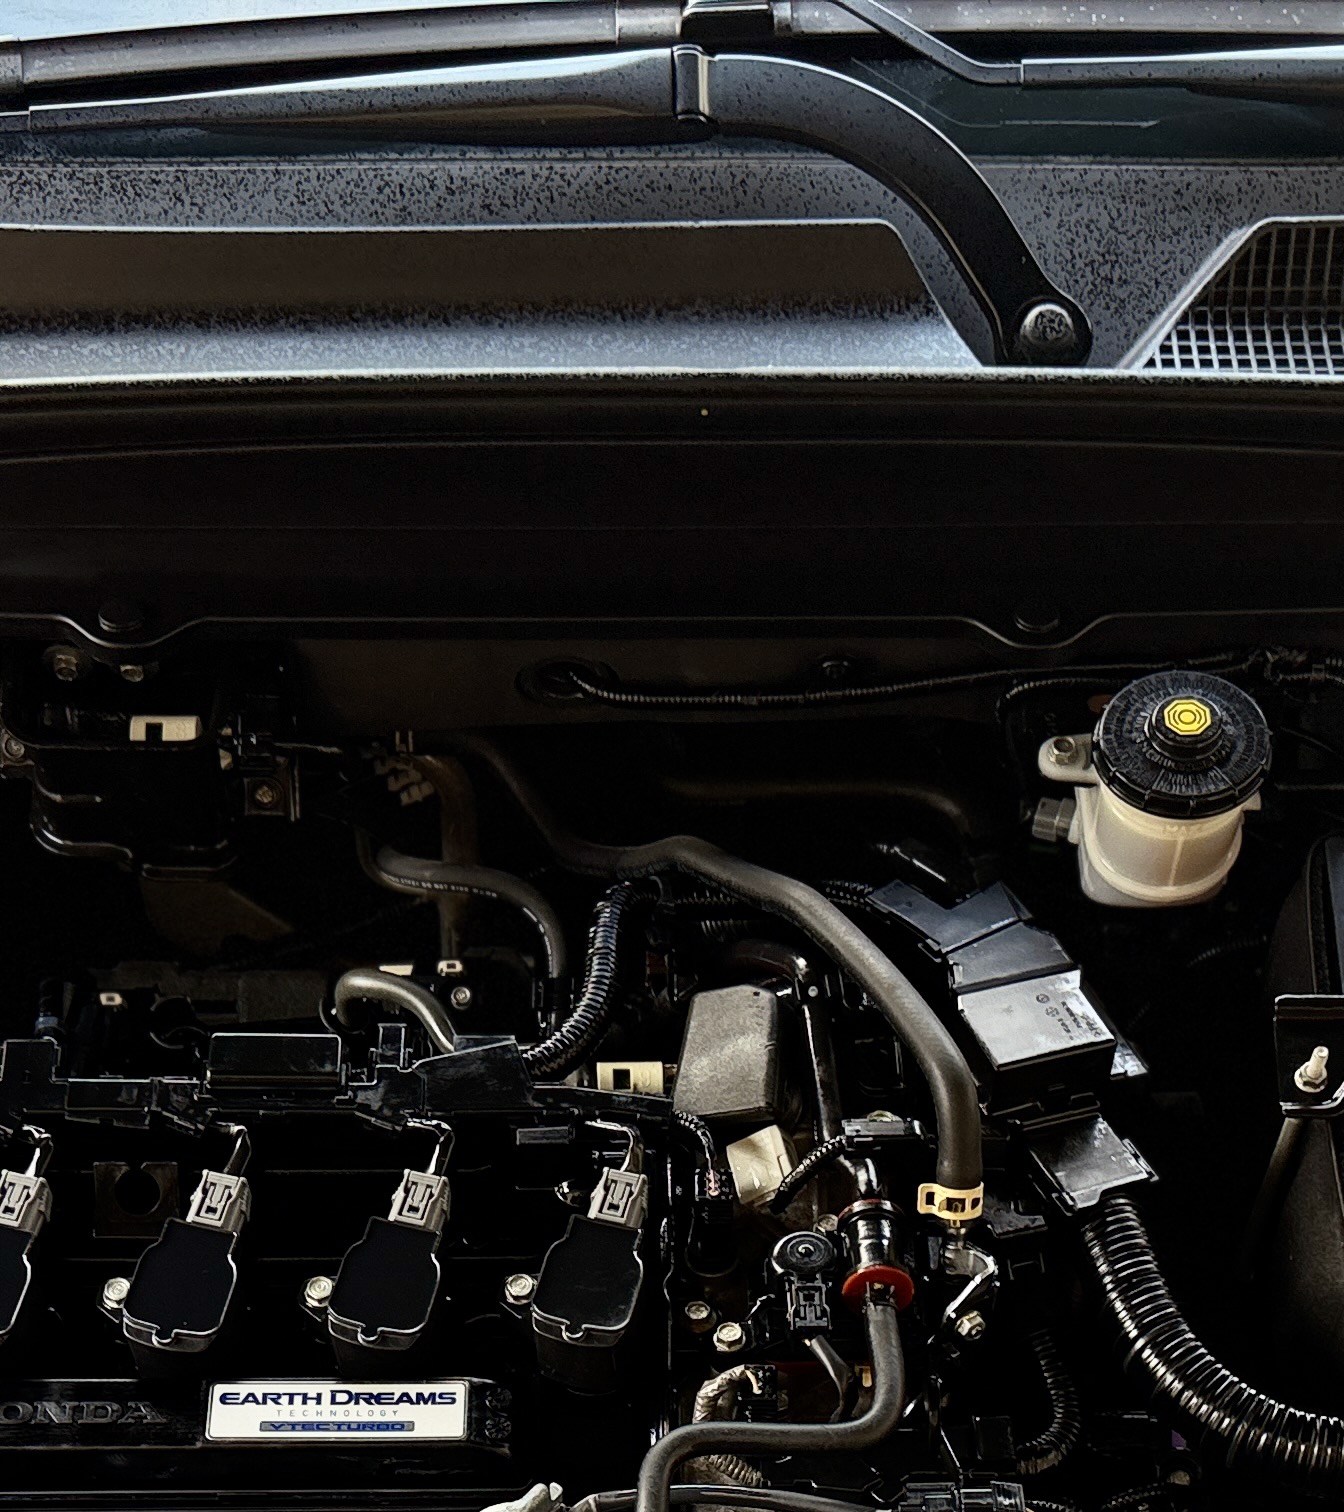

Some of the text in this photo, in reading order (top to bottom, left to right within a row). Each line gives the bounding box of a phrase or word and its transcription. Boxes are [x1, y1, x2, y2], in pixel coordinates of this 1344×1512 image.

[219, 1390, 457, 1406] EARTH DREAMS
[276, 1409, 399, 1417] TECHNOLOGY
